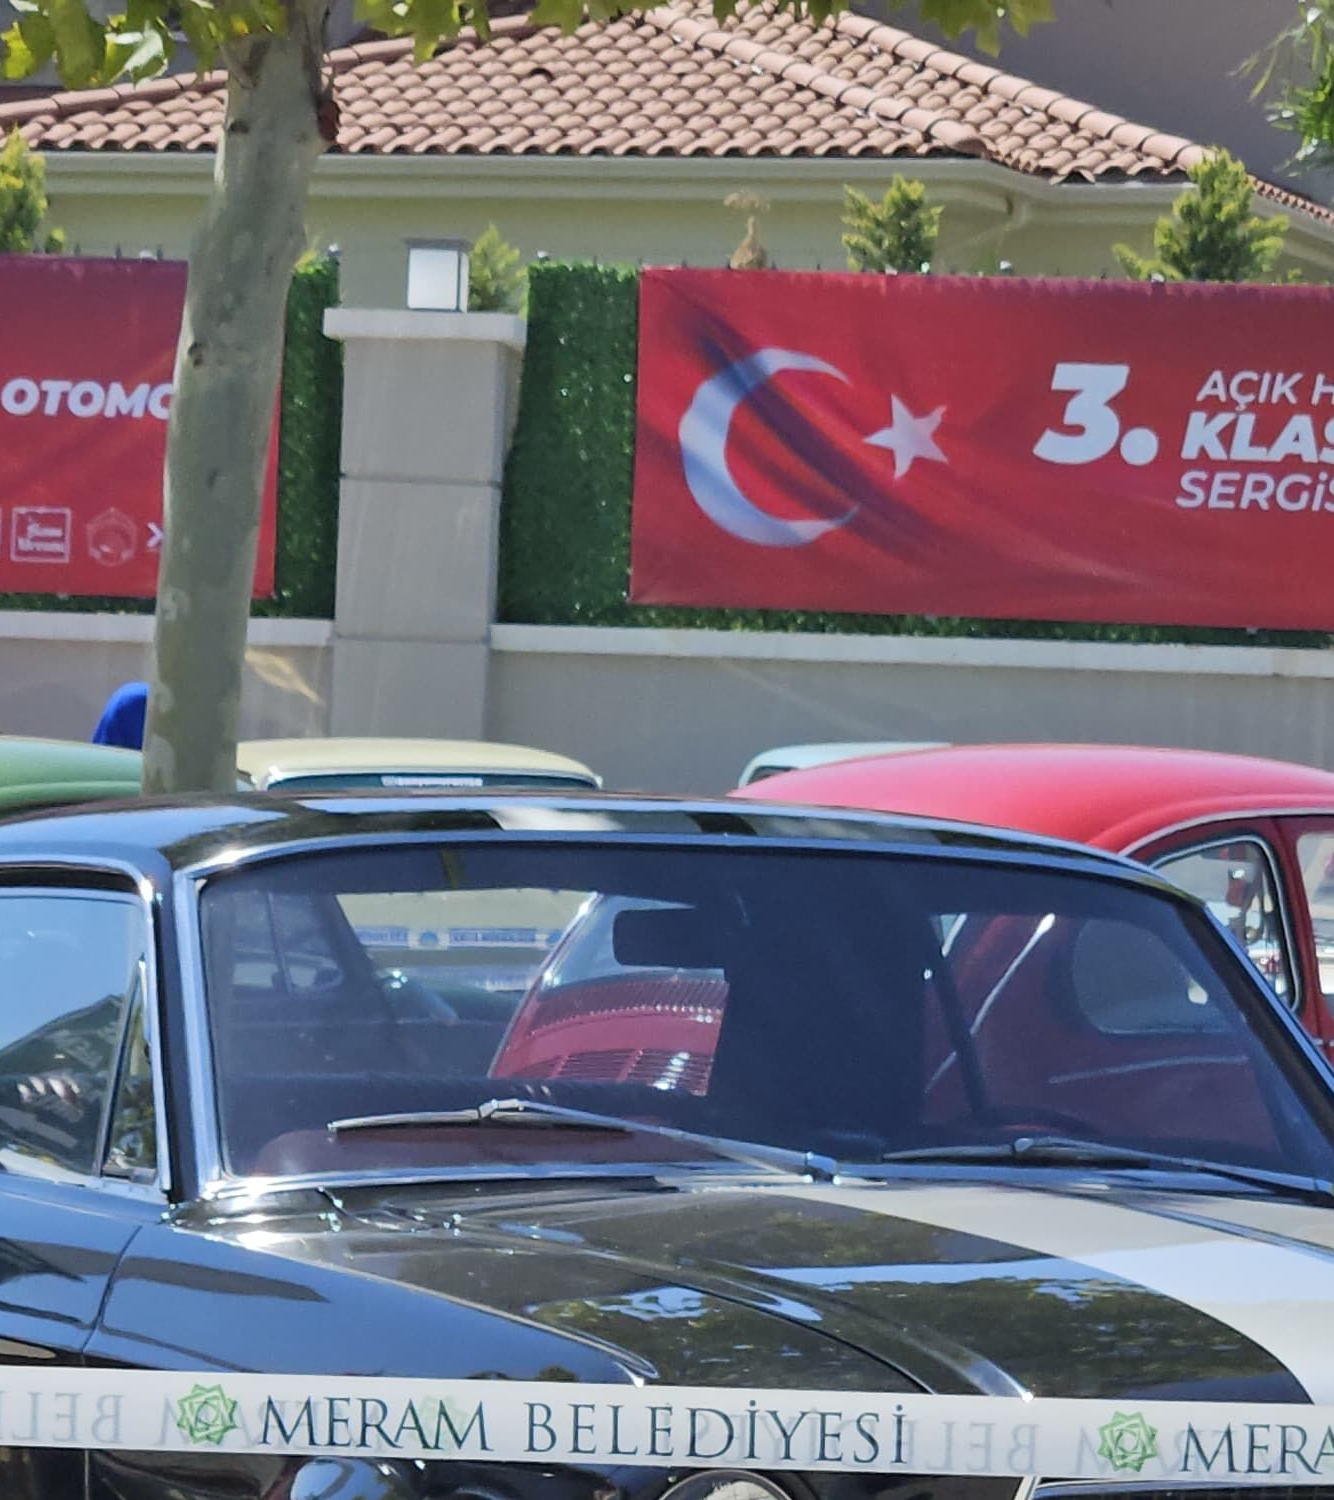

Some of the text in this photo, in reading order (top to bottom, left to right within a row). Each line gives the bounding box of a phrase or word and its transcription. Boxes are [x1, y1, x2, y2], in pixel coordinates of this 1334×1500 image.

[1033, 363, 1159, 465] 3.
[1197, 371, 1304, 411] AÇIK
[259, 1395, 495, 1452] MERAM
[524, 1399, 908, 1465] BELEDİYESİ
